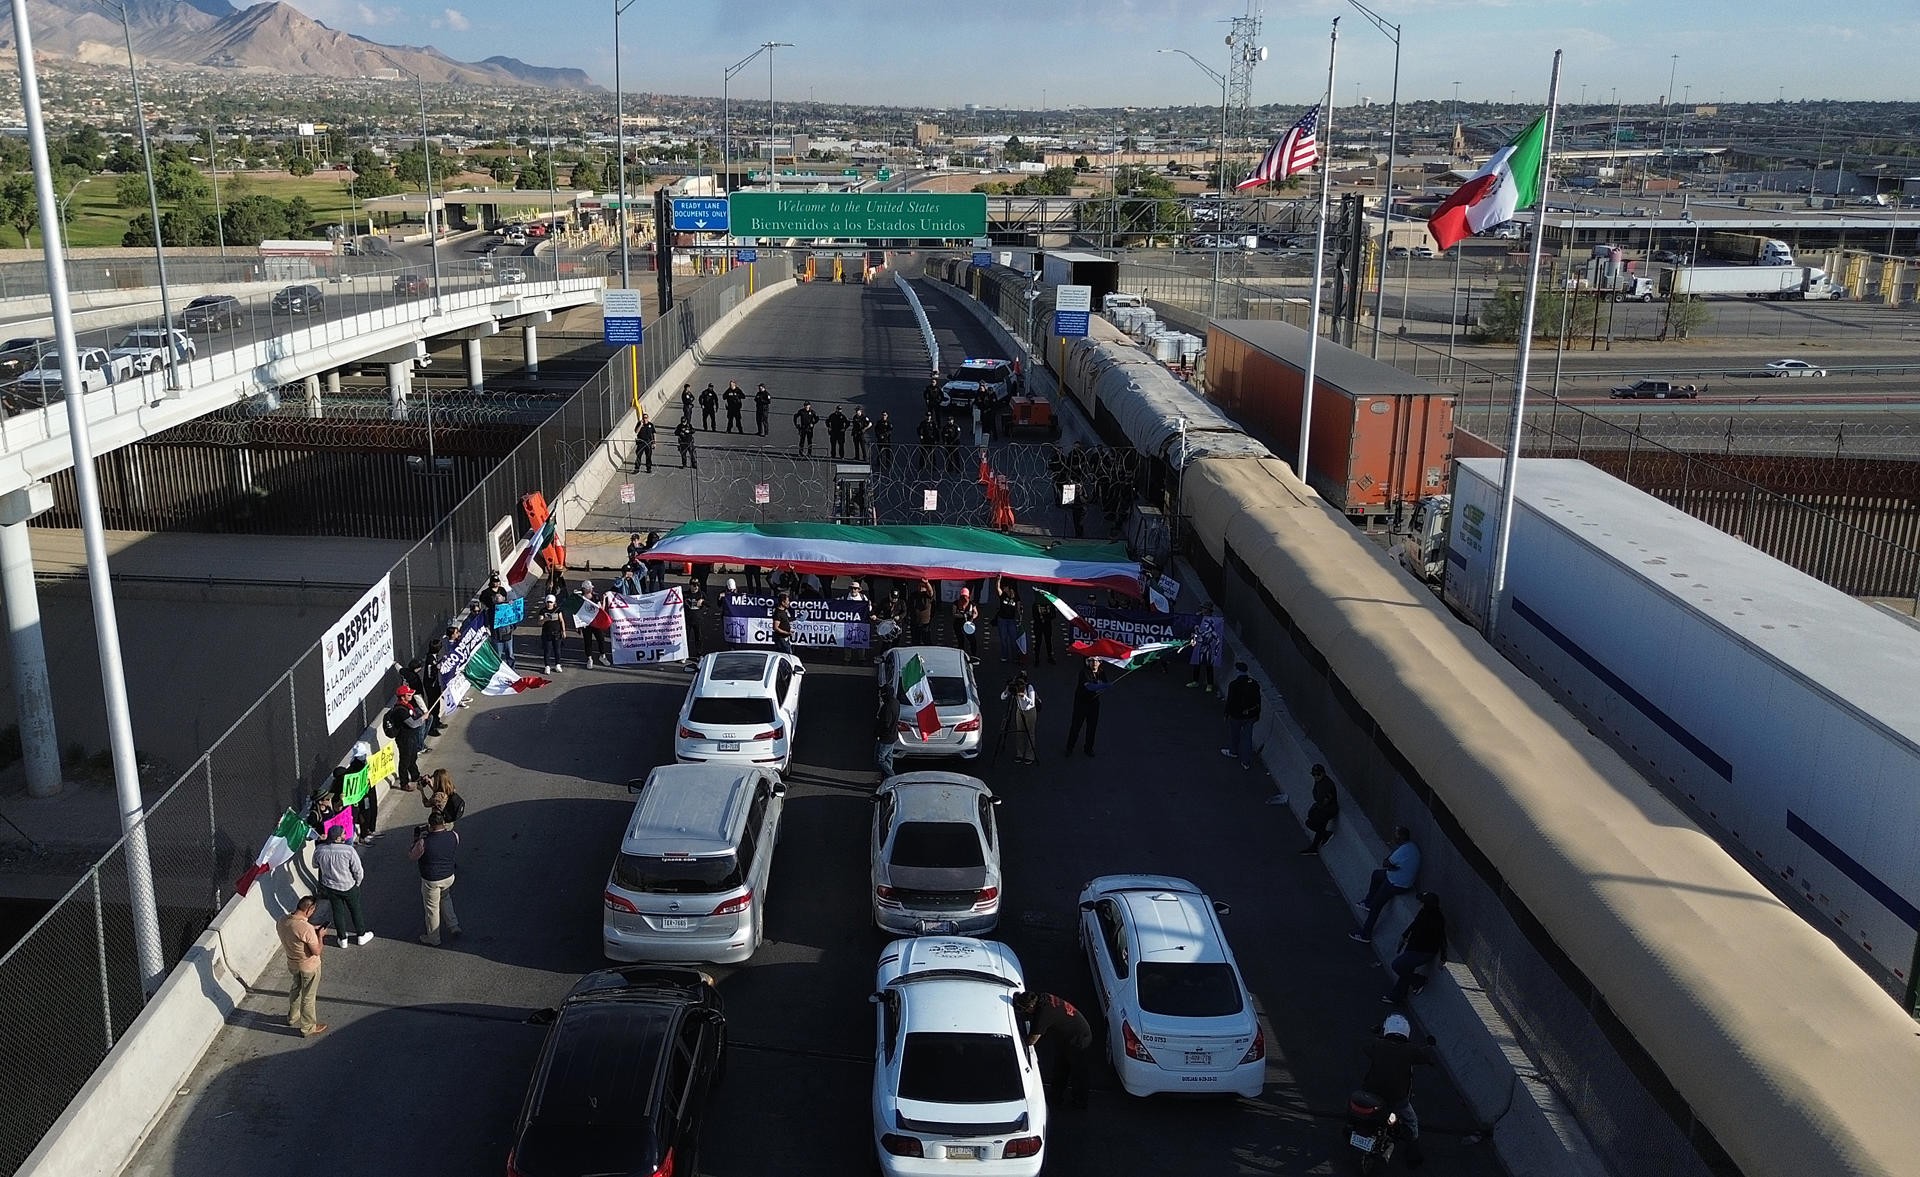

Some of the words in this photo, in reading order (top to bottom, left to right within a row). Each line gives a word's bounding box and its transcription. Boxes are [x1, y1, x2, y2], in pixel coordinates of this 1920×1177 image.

[777, 200, 826, 213] Welcome
[830, 202, 840, 213] to
[844, 201, 860, 213] the
[866, 201, 902, 213] United
[906, 201, 940, 213] States
[752, 218, 828, 231] Bienvenidos
[834, 222, 840, 231] a
[845, 218, 862, 231] los
[868, 218, 916, 231] Estados
[920, 218, 966, 231] Unidos
[732, 595, 774, 606] MÉXICO
[790, 601, 829, 610] CUCHA
[809, 610, 822, 619] TU
[825, 611, 862, 621] LUCHA
[337, 596, 379, 662] RESPETO
[1084, 618, 1174, 636] DEPENDENCIA
[755, 631, 837, 645] CHUAHUA
[1074, 627, 1134, 645] JUICIAL
[636, 649, 665, 661] PJF
[326, 683, 330, 695] A
[331, 675, 339, 690] LA
[363, 644, 369, 656] DE
[327, 703, 331, 716] E
[331, 662, 373, 712] INDEPENDENCIA
